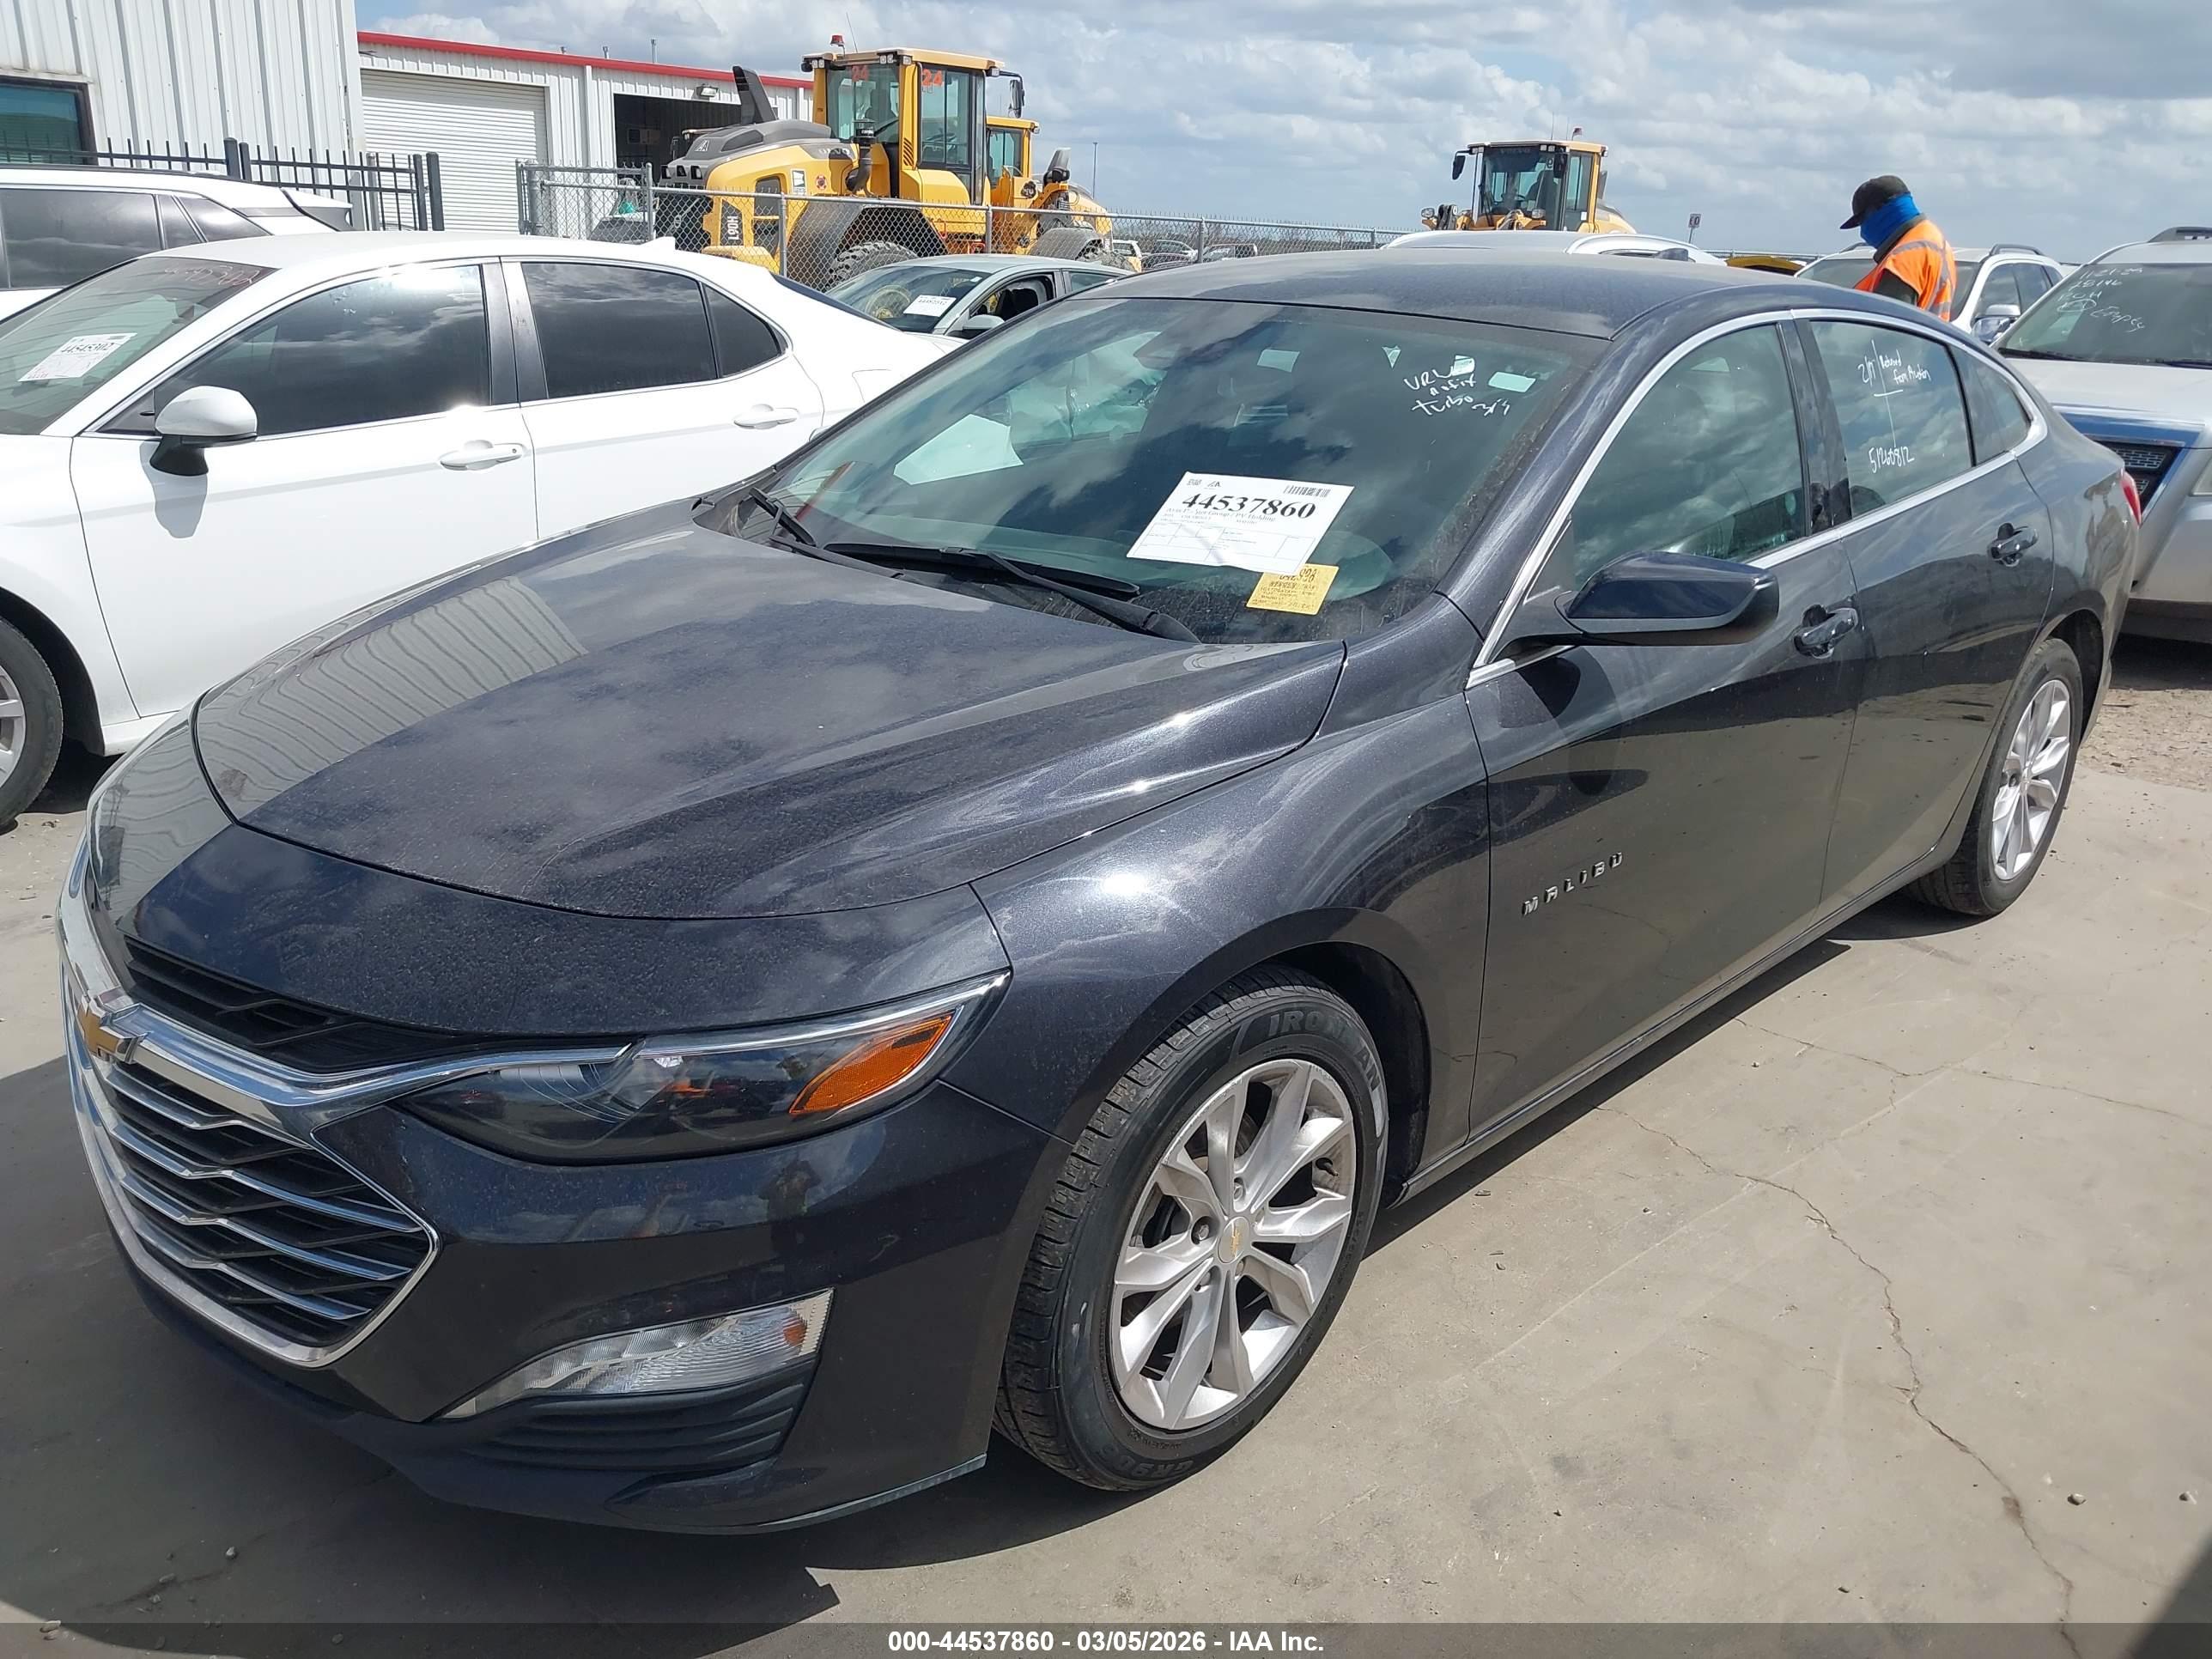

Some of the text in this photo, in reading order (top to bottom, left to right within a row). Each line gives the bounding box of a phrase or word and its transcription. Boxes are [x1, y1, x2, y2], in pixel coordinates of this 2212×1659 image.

[921, 68, 943, 86] 24
[1182, 492, 1316, 520] 44537860
[1522, 852, 1623, 916] MALIBU
